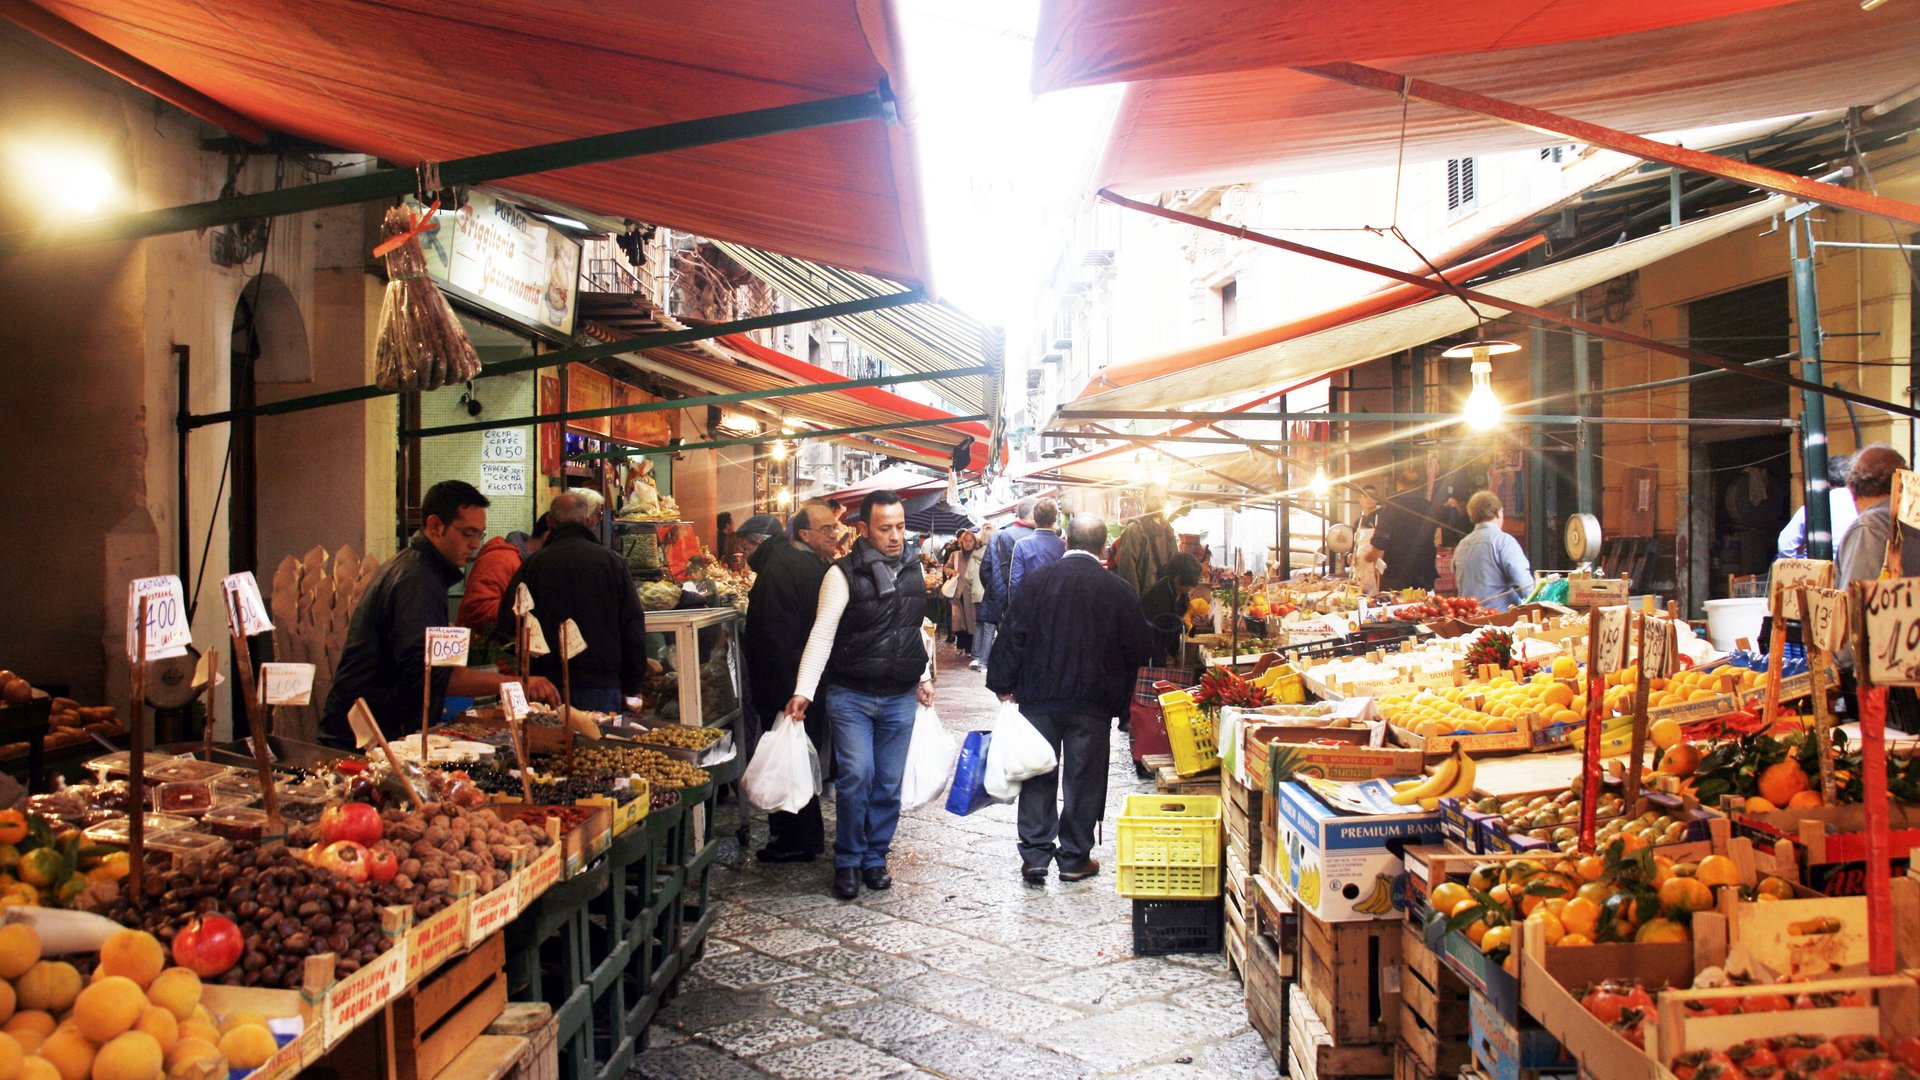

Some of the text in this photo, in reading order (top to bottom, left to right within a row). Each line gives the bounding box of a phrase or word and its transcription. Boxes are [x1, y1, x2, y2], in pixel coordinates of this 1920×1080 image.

[479, 255, 542, 305] Gastronomia
[433, 640, 461, 657] 0,60
[1340, 825, 1400, 839] PREMIUM
